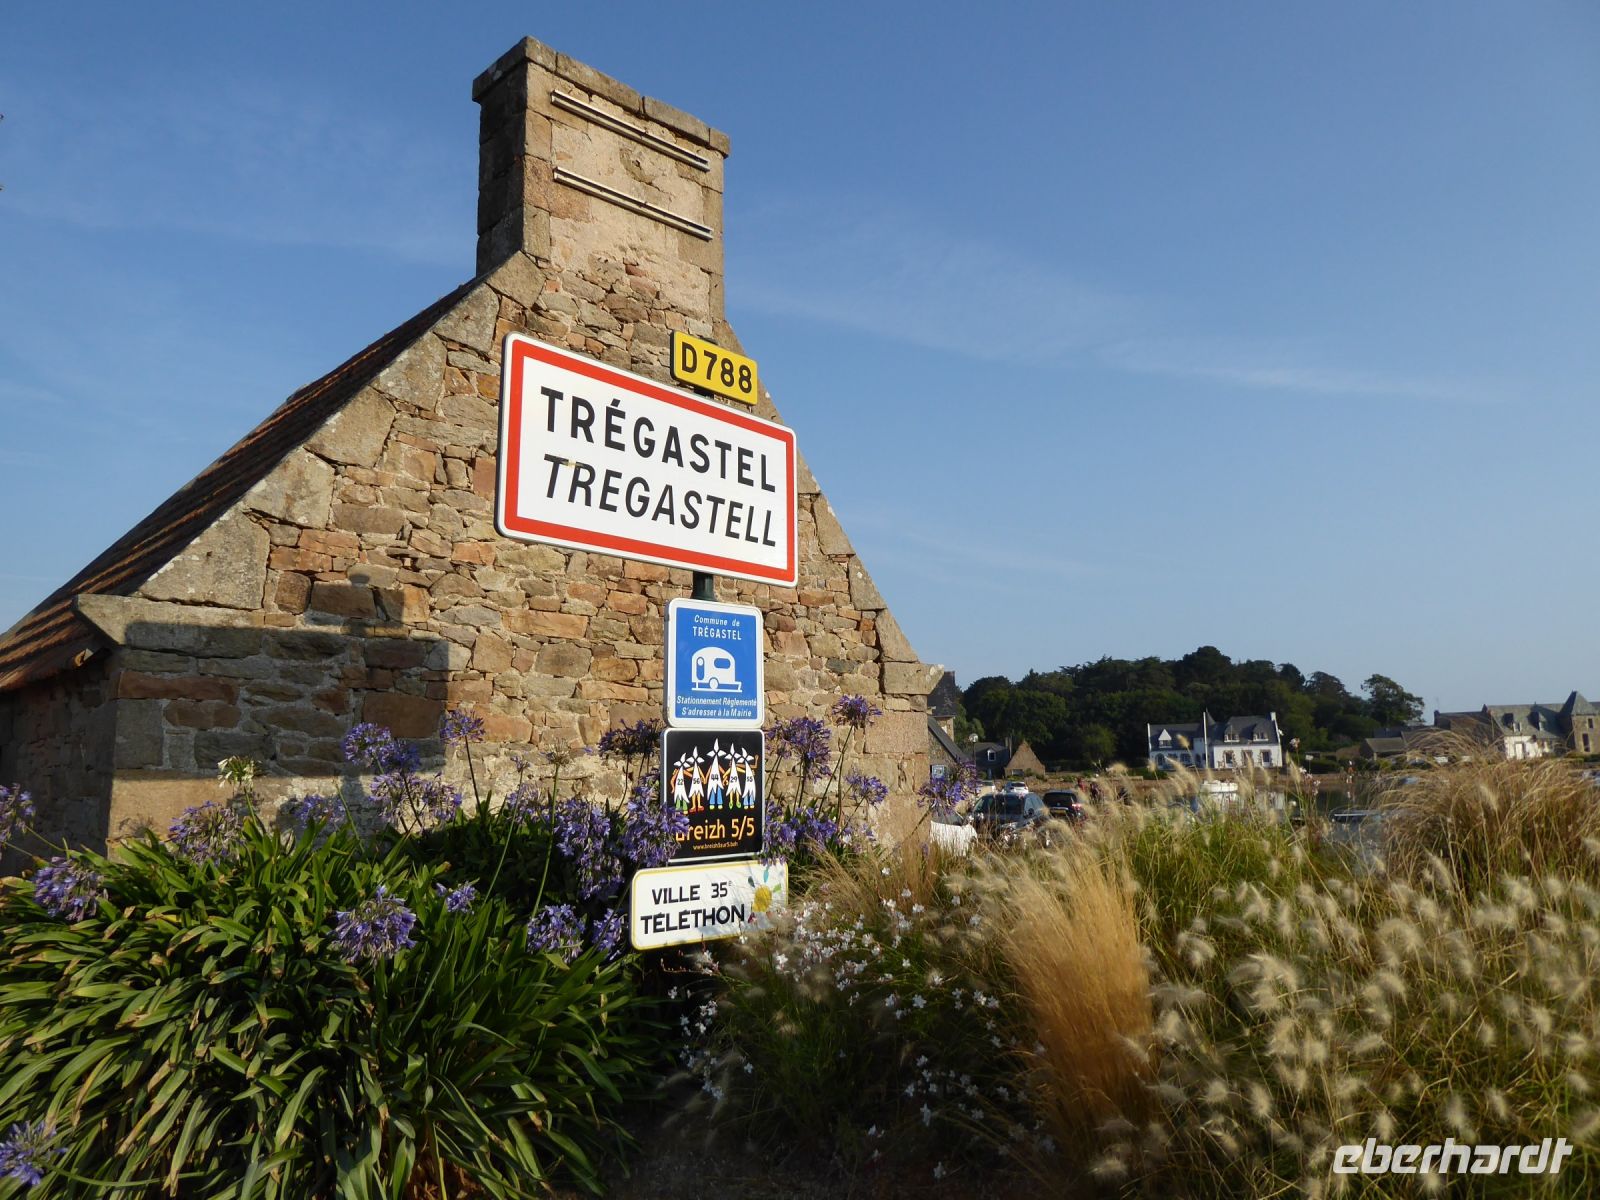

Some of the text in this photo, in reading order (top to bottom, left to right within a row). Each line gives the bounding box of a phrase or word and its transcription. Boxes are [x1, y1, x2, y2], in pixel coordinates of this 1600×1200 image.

[681, 341, 753, 394] D788
[540, 385, 776, 493] TRÉGASTEL
[543, 453, 776, 547] TREGASTELL
[694, 614, 740, 627] Commune de
[692, 625, 742, 640] TRÉGASTEL
[676, 695, 721, 706] Stationnement
[681, 706, 717, 716] S'adresser
[723, 708, 730, 717] la
[731, 709, 752, 717] Mairie
[693, 777, 701, 785] 56
[731, 816, 755, 840] 5/5
[652, 885, 700, 904] VILLE
[640, 904, 745, 935] TÉLÉTHON
